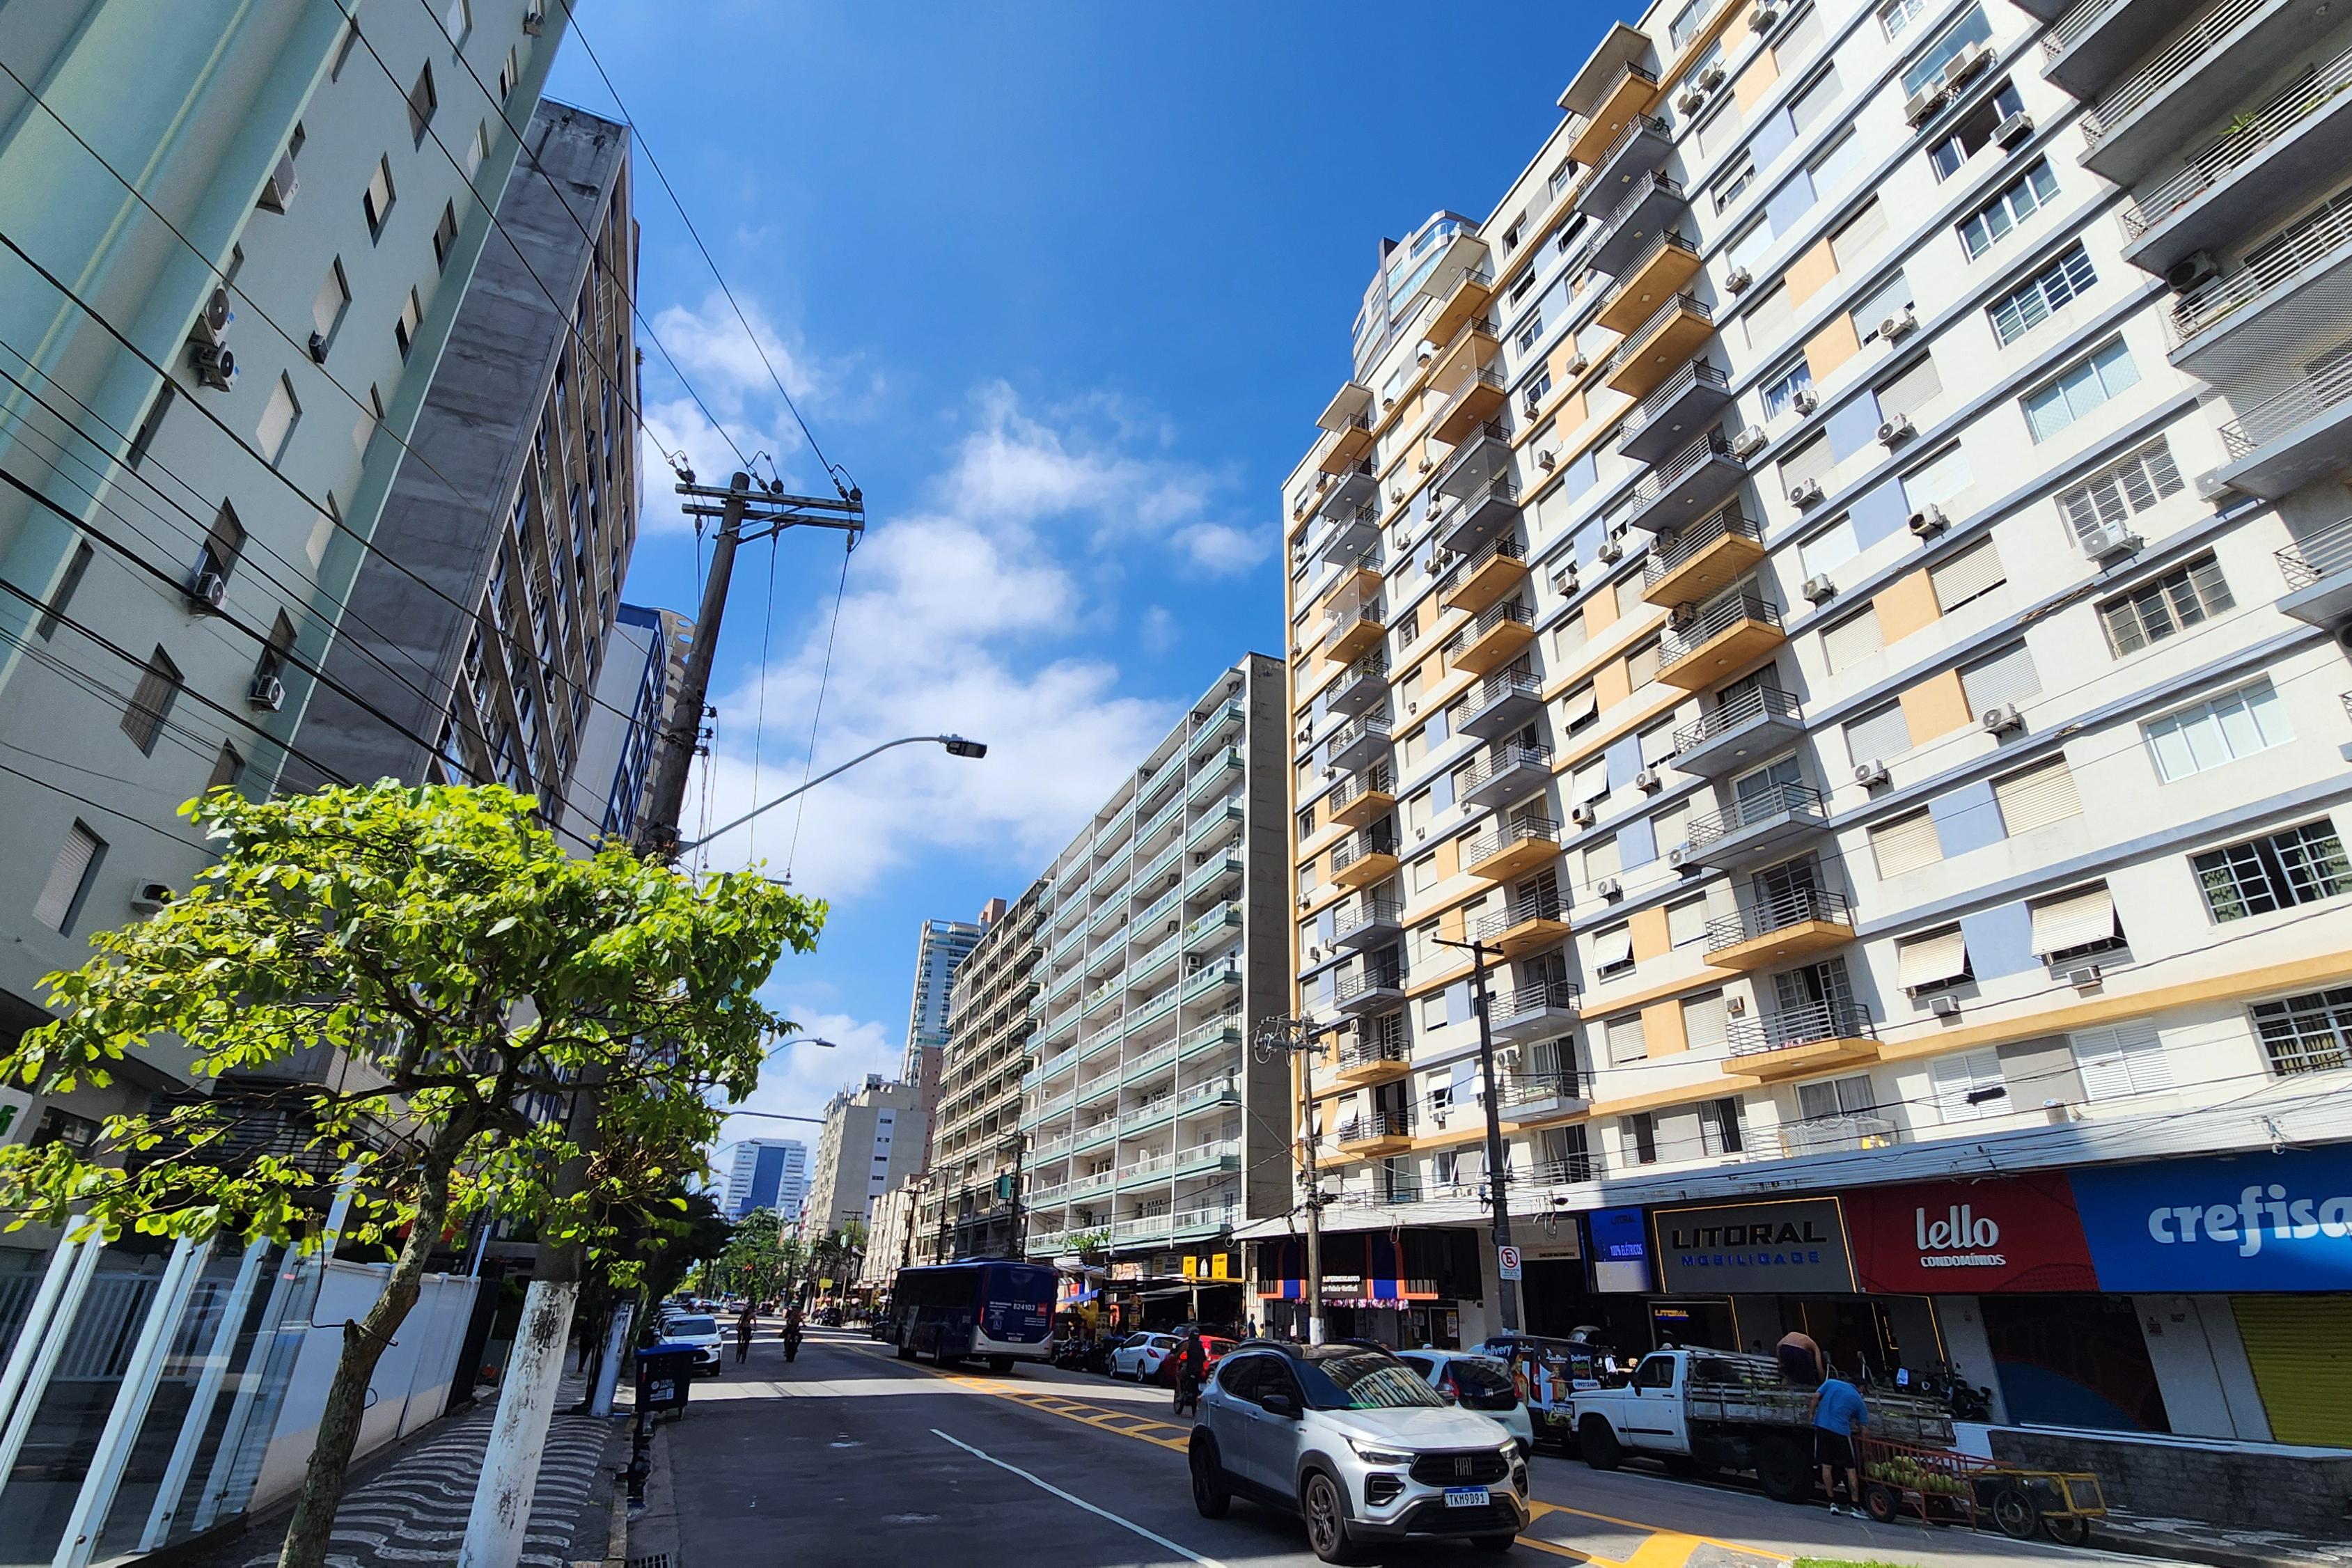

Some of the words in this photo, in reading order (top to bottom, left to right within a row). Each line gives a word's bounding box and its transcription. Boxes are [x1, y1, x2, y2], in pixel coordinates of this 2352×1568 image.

[1611, 1214, 1636, 1225] LITORAL
[1916, 1204, 1999, 1250] lello
[2148, 1184, 2352, 1257] crefisa
[1672, 1221, 1828, 1250] LITORAL
[1610, 1244, 1621, 1257] 100%
[1621, 1241, 1643, 1256] ELÉTRICOS
[1681, 1251, 1820, 1267] MOBILIDADE
[1920, 1253, 2007, 1267] CONDOMÍNIOS
[1013, 1303, 1036, 1312] 824103
[1654, 1309, 1689, 1317] LITORAL
[1571, 1354, 1591, 1363] Delivery
[1454, 1457, 1473, 1477] FIAT
[1449, 1493, 1485, 1506] TKM9D91
